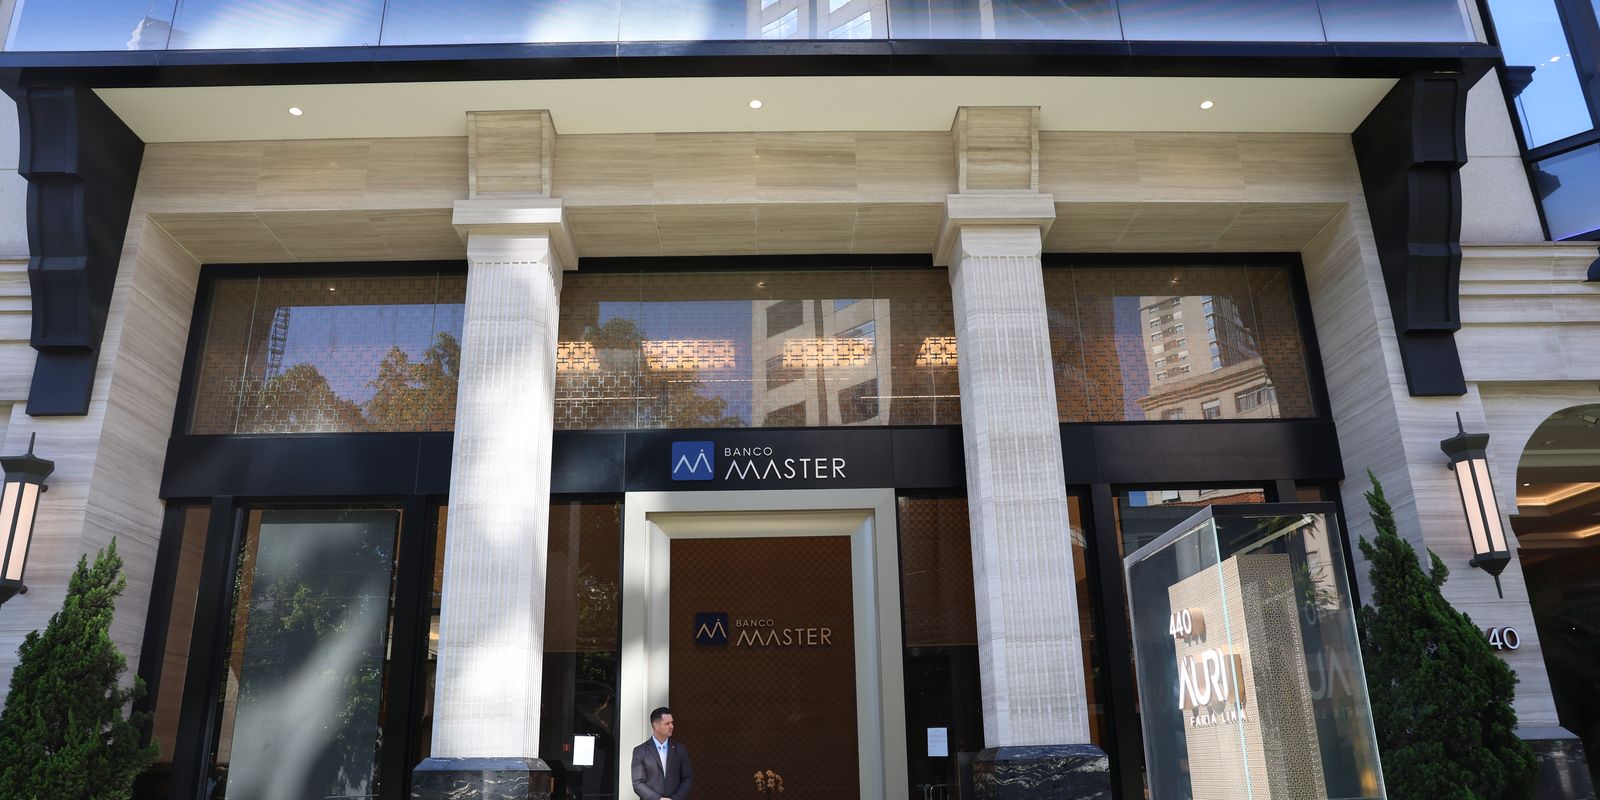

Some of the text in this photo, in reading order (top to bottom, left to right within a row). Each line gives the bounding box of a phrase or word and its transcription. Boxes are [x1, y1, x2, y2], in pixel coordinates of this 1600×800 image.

[724, 447, 773, 457] BANCO
[725, 458, 846, 480] MASTER
[736, 619, 774, 627] BANCO
[1169, 608, 1192, 639] 440
[736, 627, 832, 646] MASTER
[1190, 713, 1218, 728] FARIA
